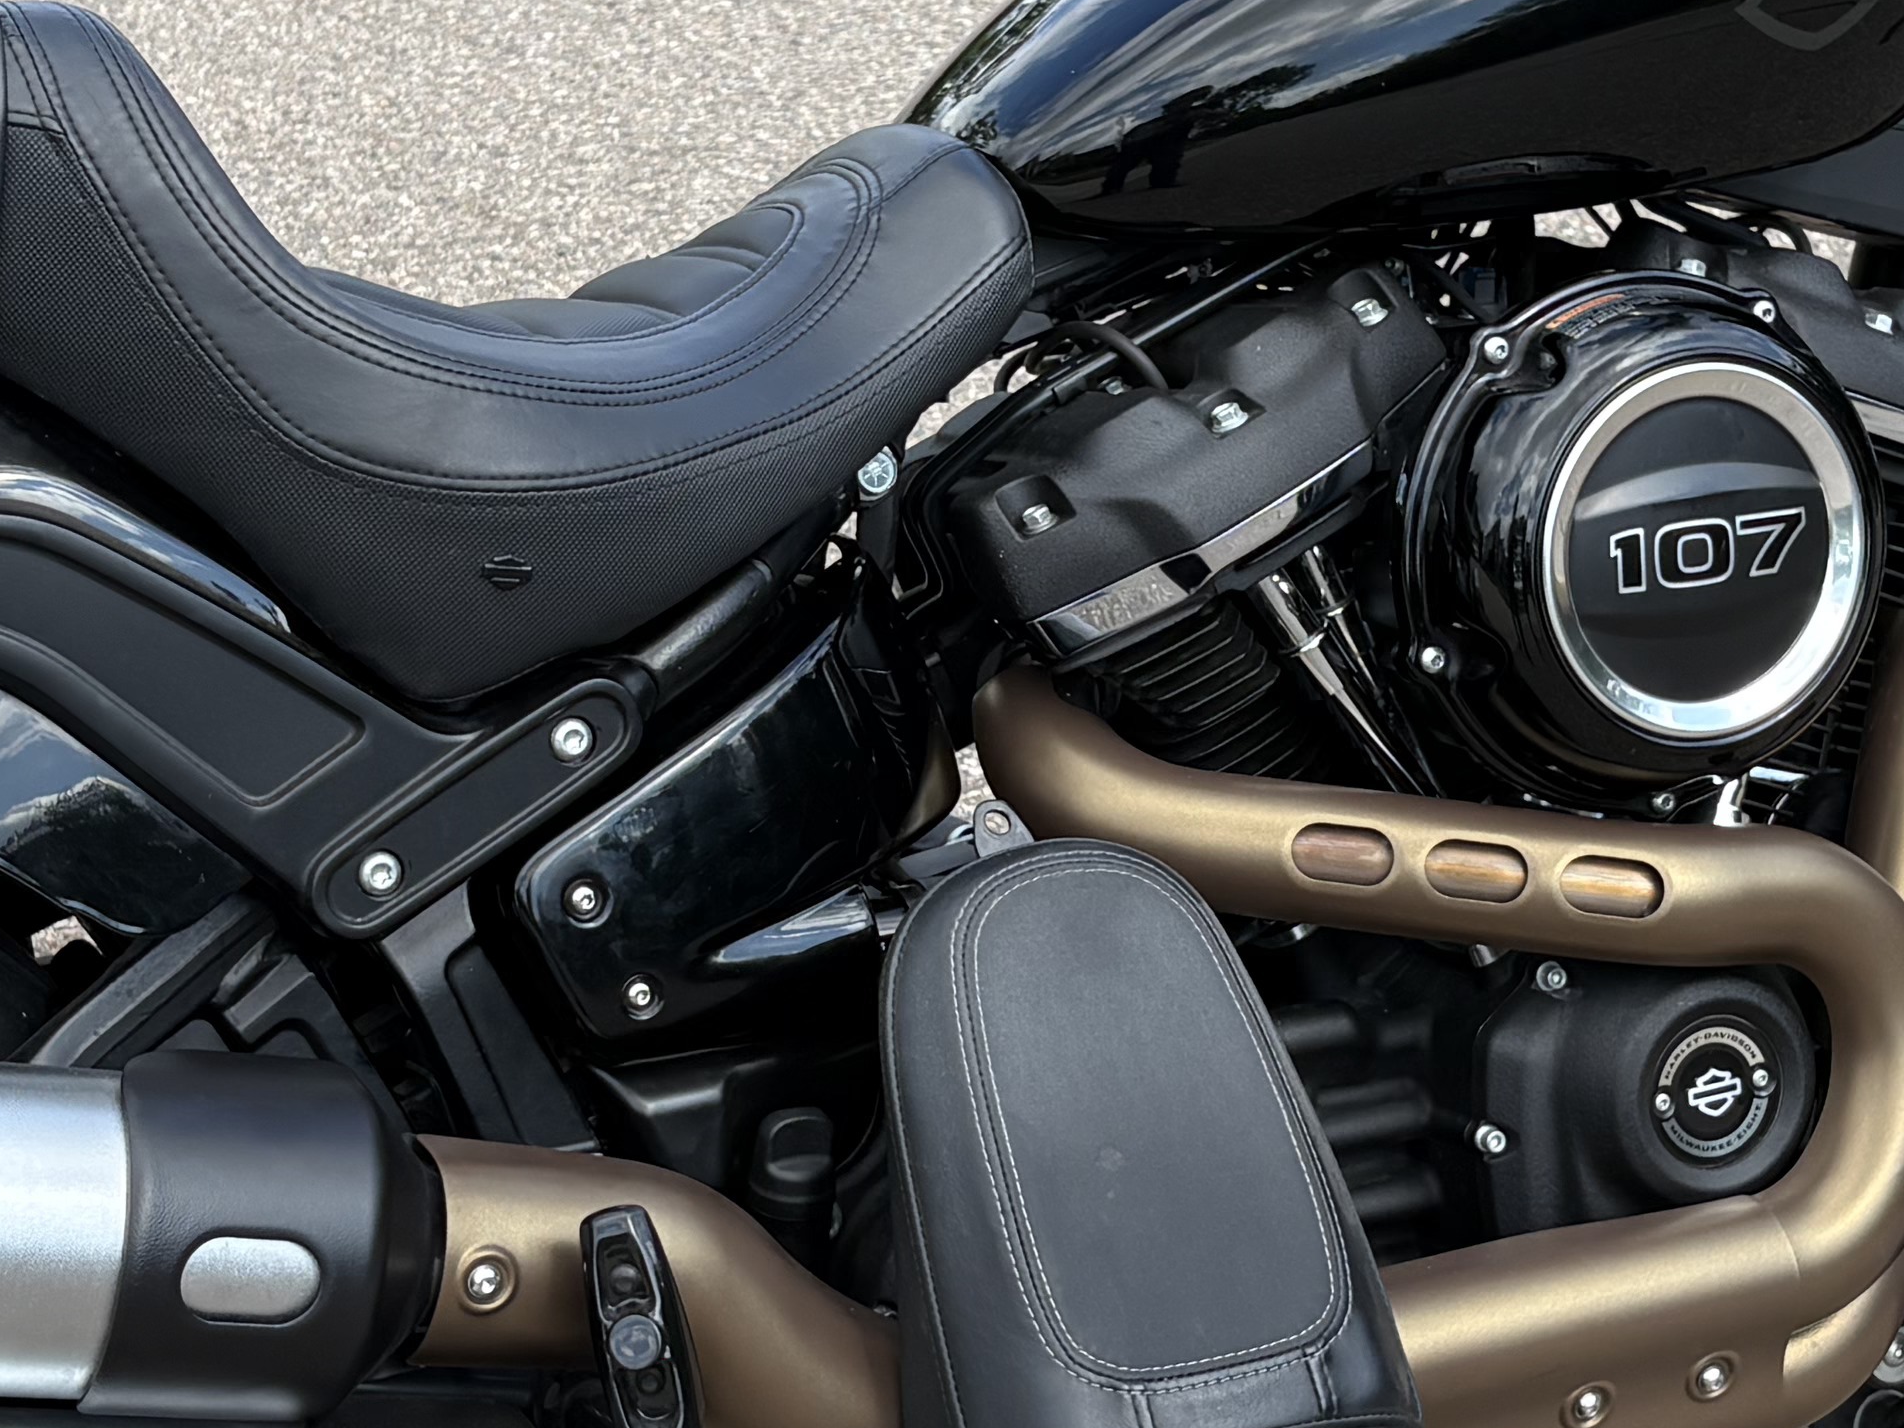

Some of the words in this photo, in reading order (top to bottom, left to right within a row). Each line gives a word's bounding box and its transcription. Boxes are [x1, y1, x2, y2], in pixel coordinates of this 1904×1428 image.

[1610, 506, 1806, 595] 107
[1664, 1030, 1757, 1081] HARLEY-DAVIDSON
[1669, 1103, 1761, 1153] MILWAUKEE-EIGHT
